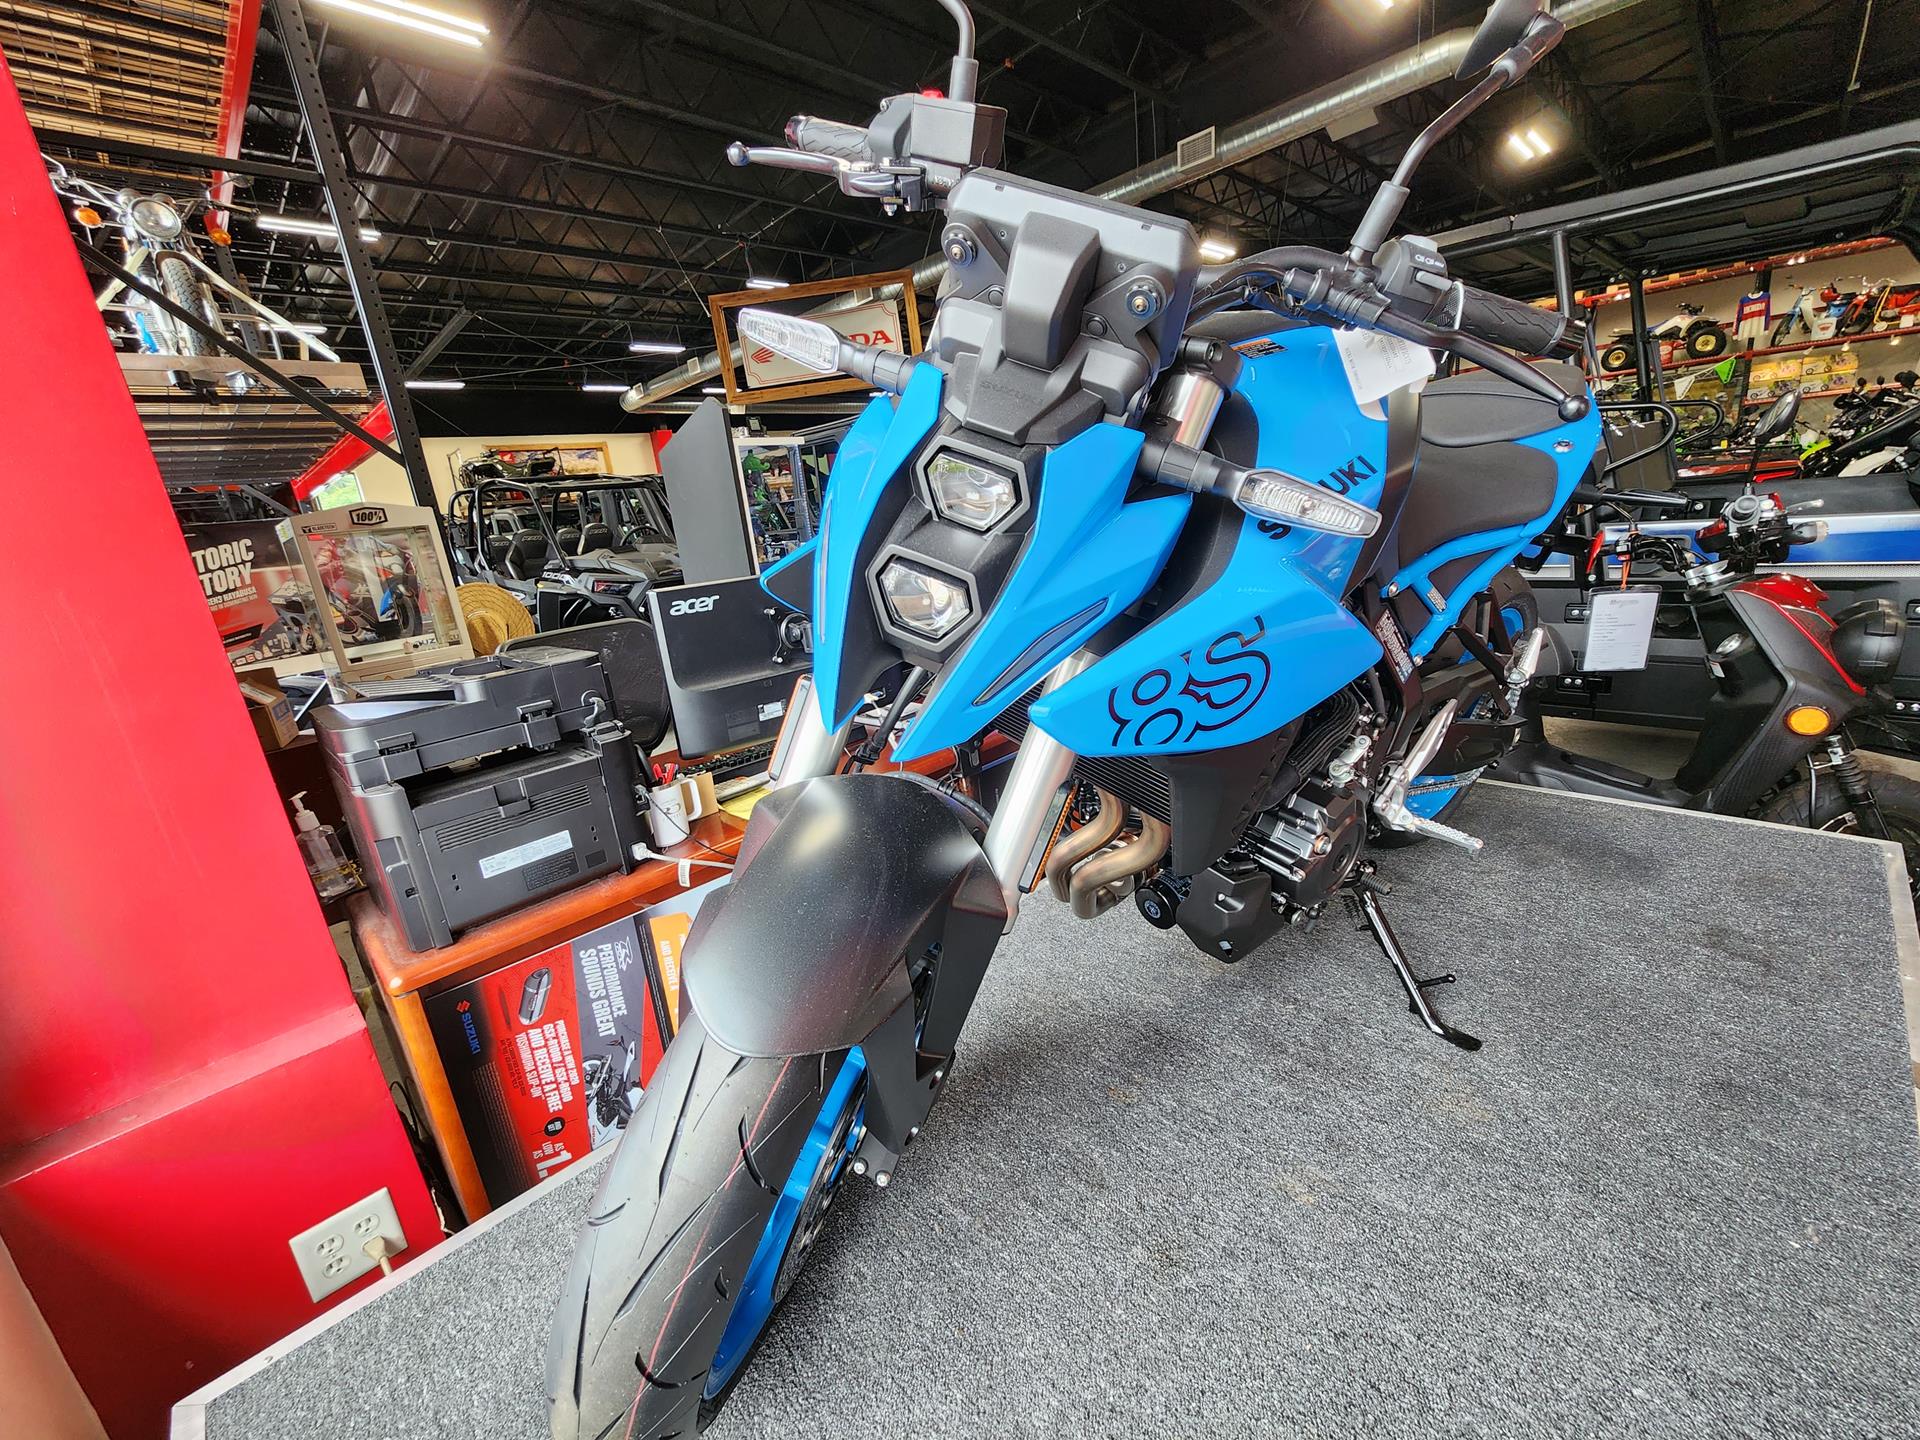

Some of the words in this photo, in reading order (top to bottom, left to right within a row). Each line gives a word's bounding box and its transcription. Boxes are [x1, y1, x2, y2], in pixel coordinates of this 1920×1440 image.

[1257, 455, 1377, 540] SUKI
[354, 510, 384, 522] 100%
[192, 538, 254, 574] TORIC
[199, 562, 252, 596] TORY
[669, 594, 720, 617] acer
[579, 948, 606, 999] SOUNDS
[597, 943, 627, 1017] PERFORMANCE
[462, 1012, 481, 1054] SUZUKI
[591, 999, 616, 1037] GREAT
[515, 1032, 535, 1072] YOSHIMURA
[528, 1028, 545, 1048] AND
[555, 1020, 571, 1051] PURCHASE
[564, 1055, 575, 1069] NEW
[533, 1047, 555, 1084] RECEIVE
[542, 1083, 556, 1092] A
[544, 1091, 562, 1113] FREE
[532, 1149, 543, 1159] AS
[541, 1142, 554, 1155] LOW
[553, 1142, 564, 1151] AS
